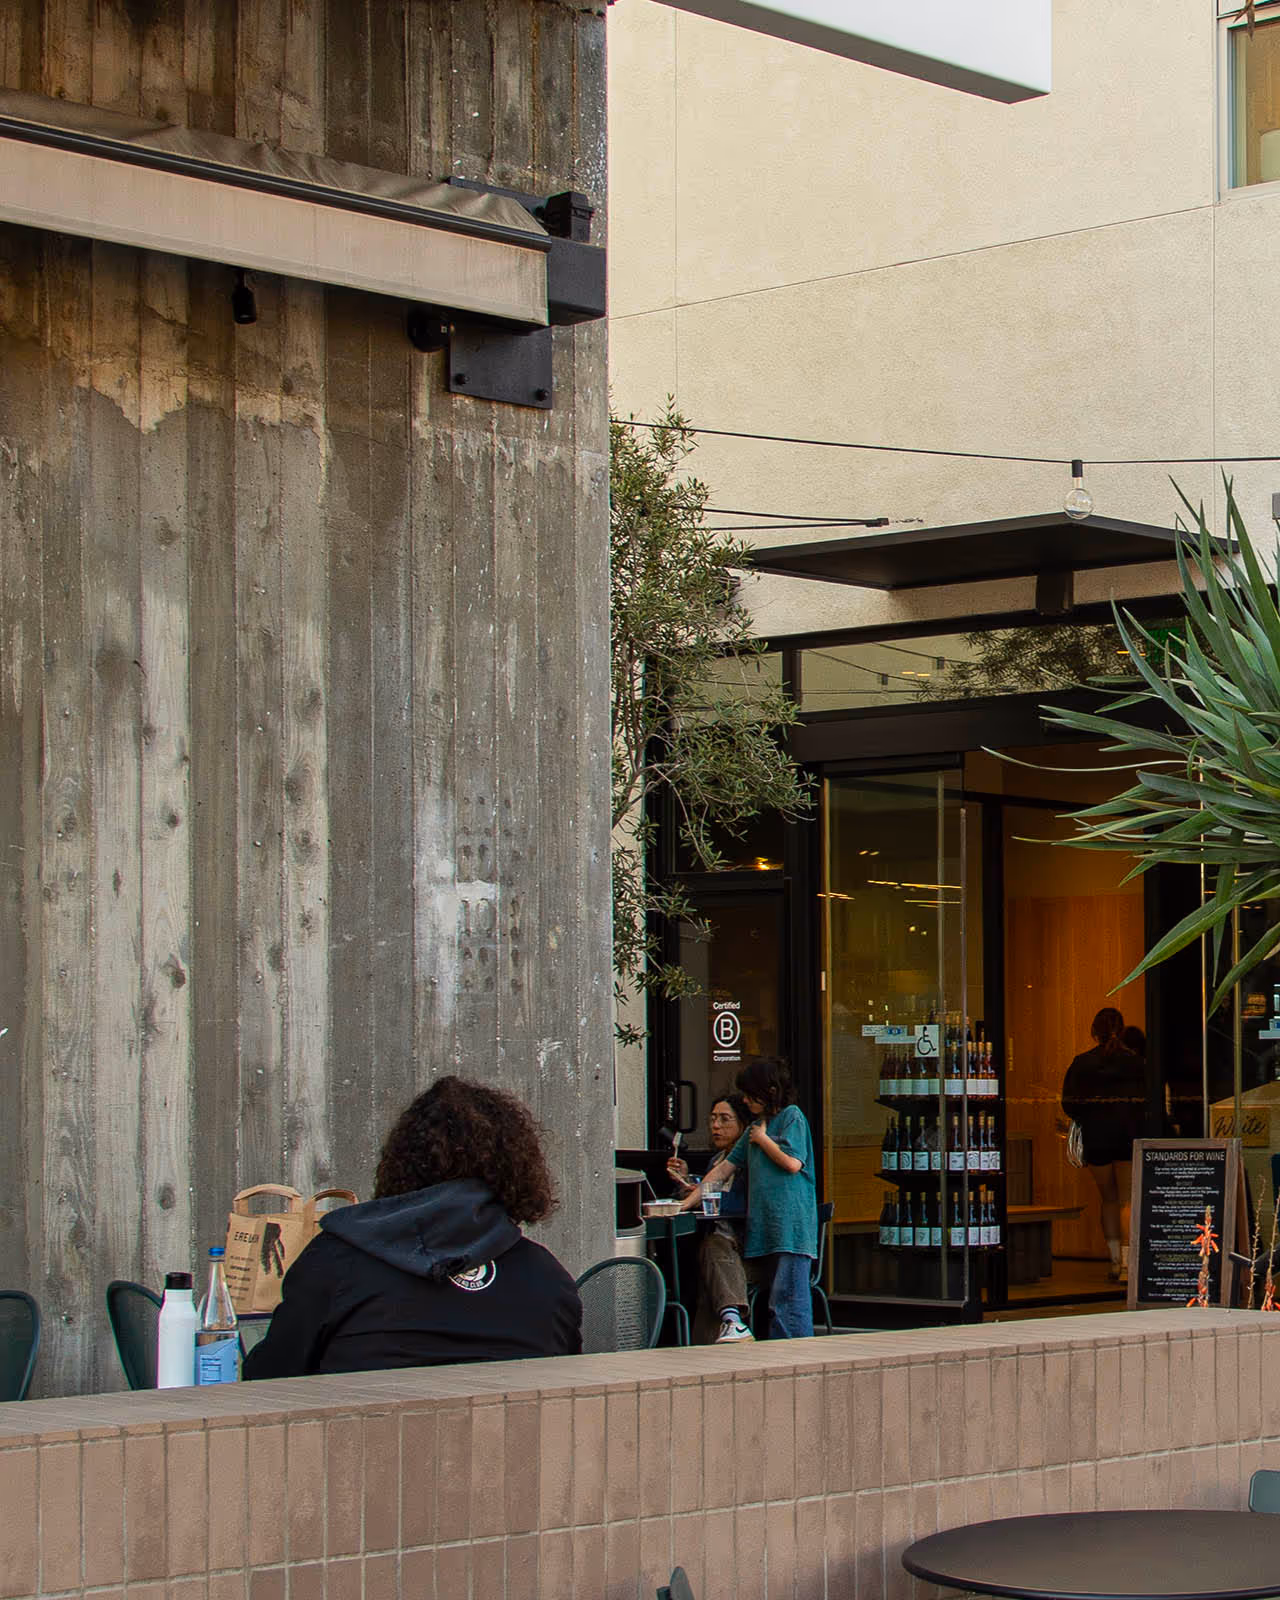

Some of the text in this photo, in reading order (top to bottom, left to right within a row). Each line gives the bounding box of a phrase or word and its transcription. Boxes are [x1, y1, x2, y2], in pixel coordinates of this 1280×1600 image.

[712, 1001, 741, 1010] Certified
[1145, 1151, 1225, 1161] STANDARDS FOR WINE
